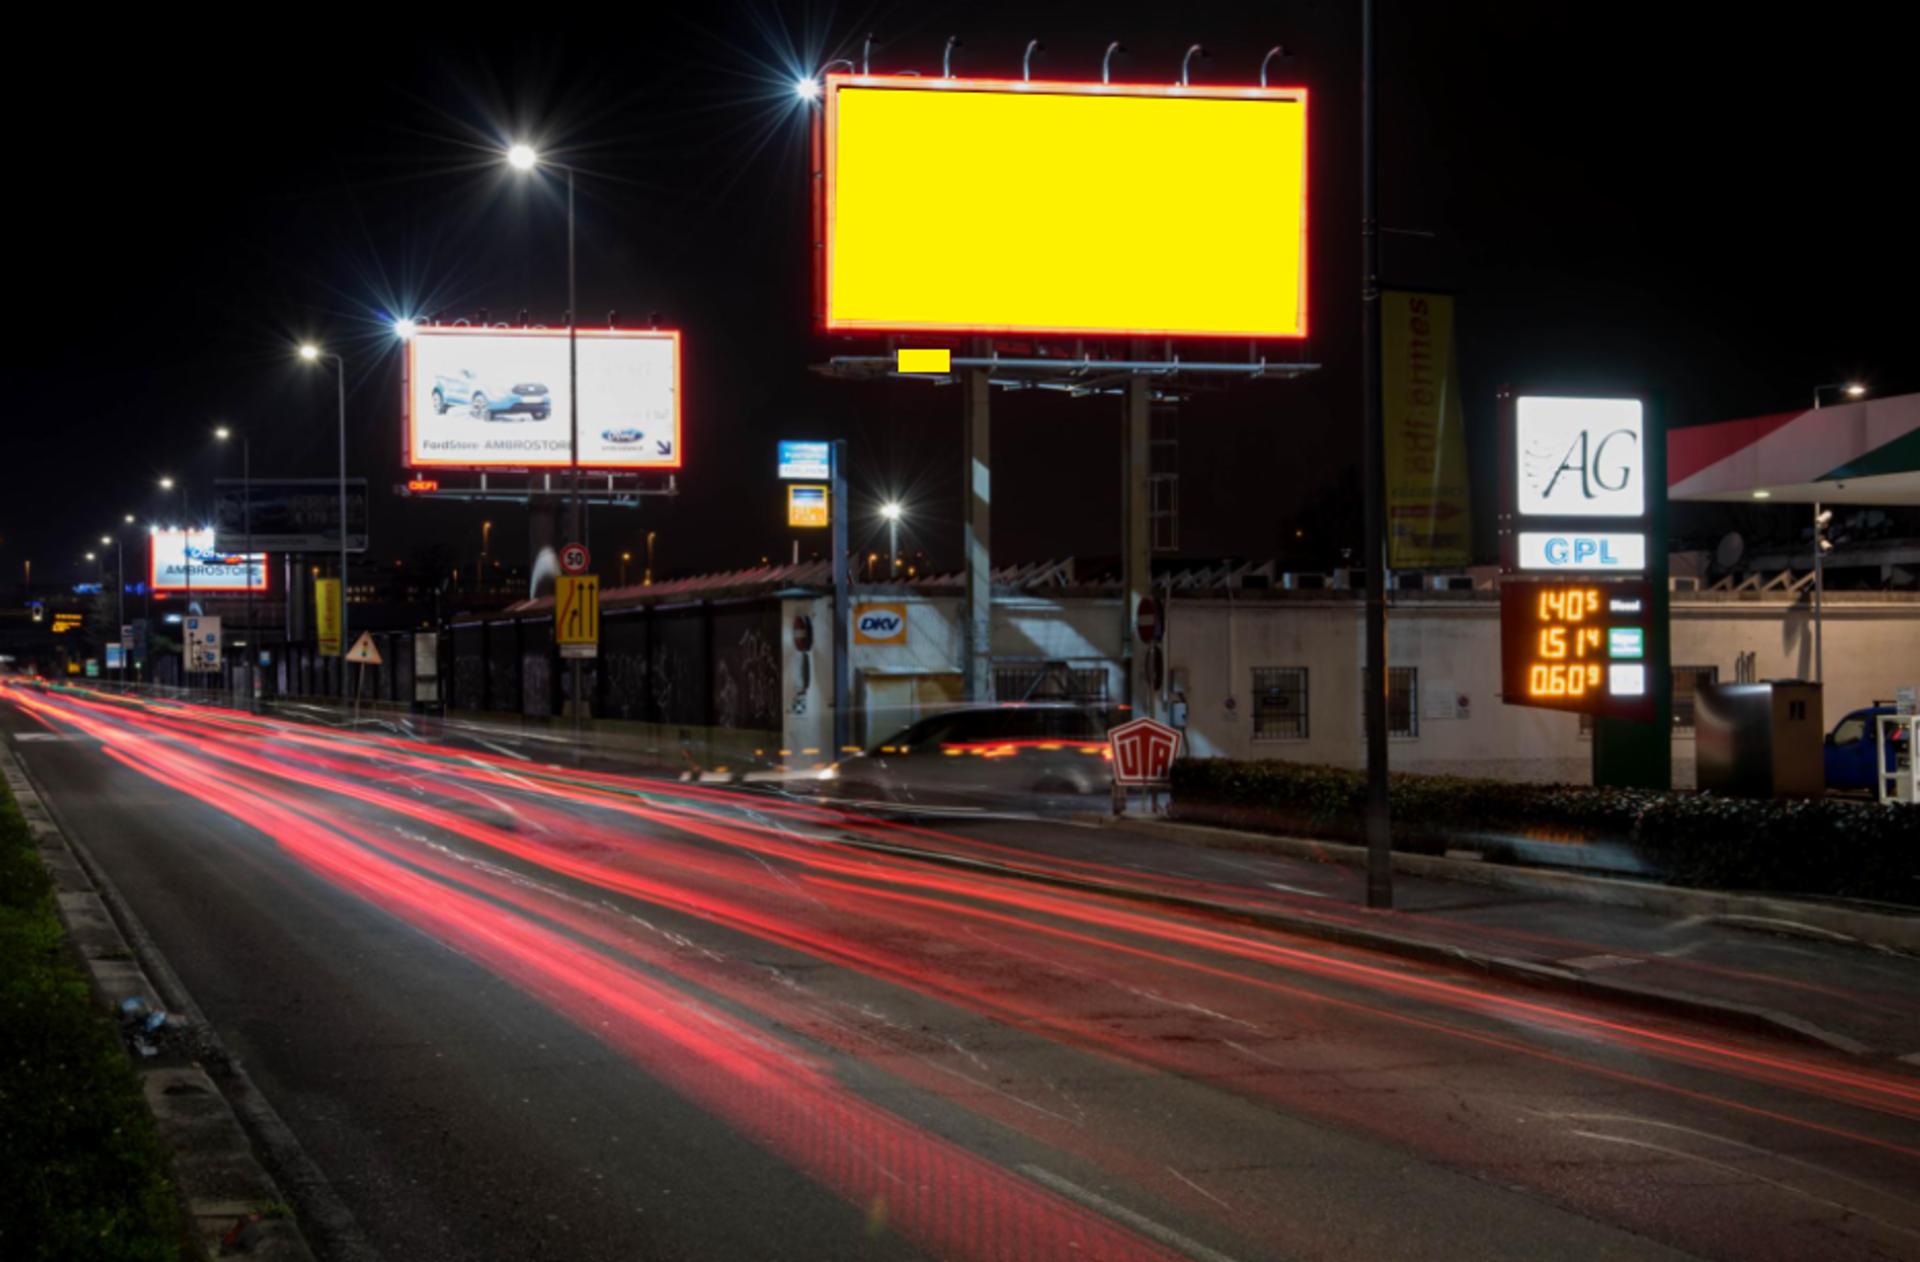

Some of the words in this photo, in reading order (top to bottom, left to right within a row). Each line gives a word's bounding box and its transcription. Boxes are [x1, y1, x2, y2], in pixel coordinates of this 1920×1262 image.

[1542, 428, 1637, 499] AG
[566, 552, 583, 566] 50
[1544, 537, 1618, 566] GPL
[859, 616, 900, 631] DKV
[1117, 725, 1173, 780] UTA
